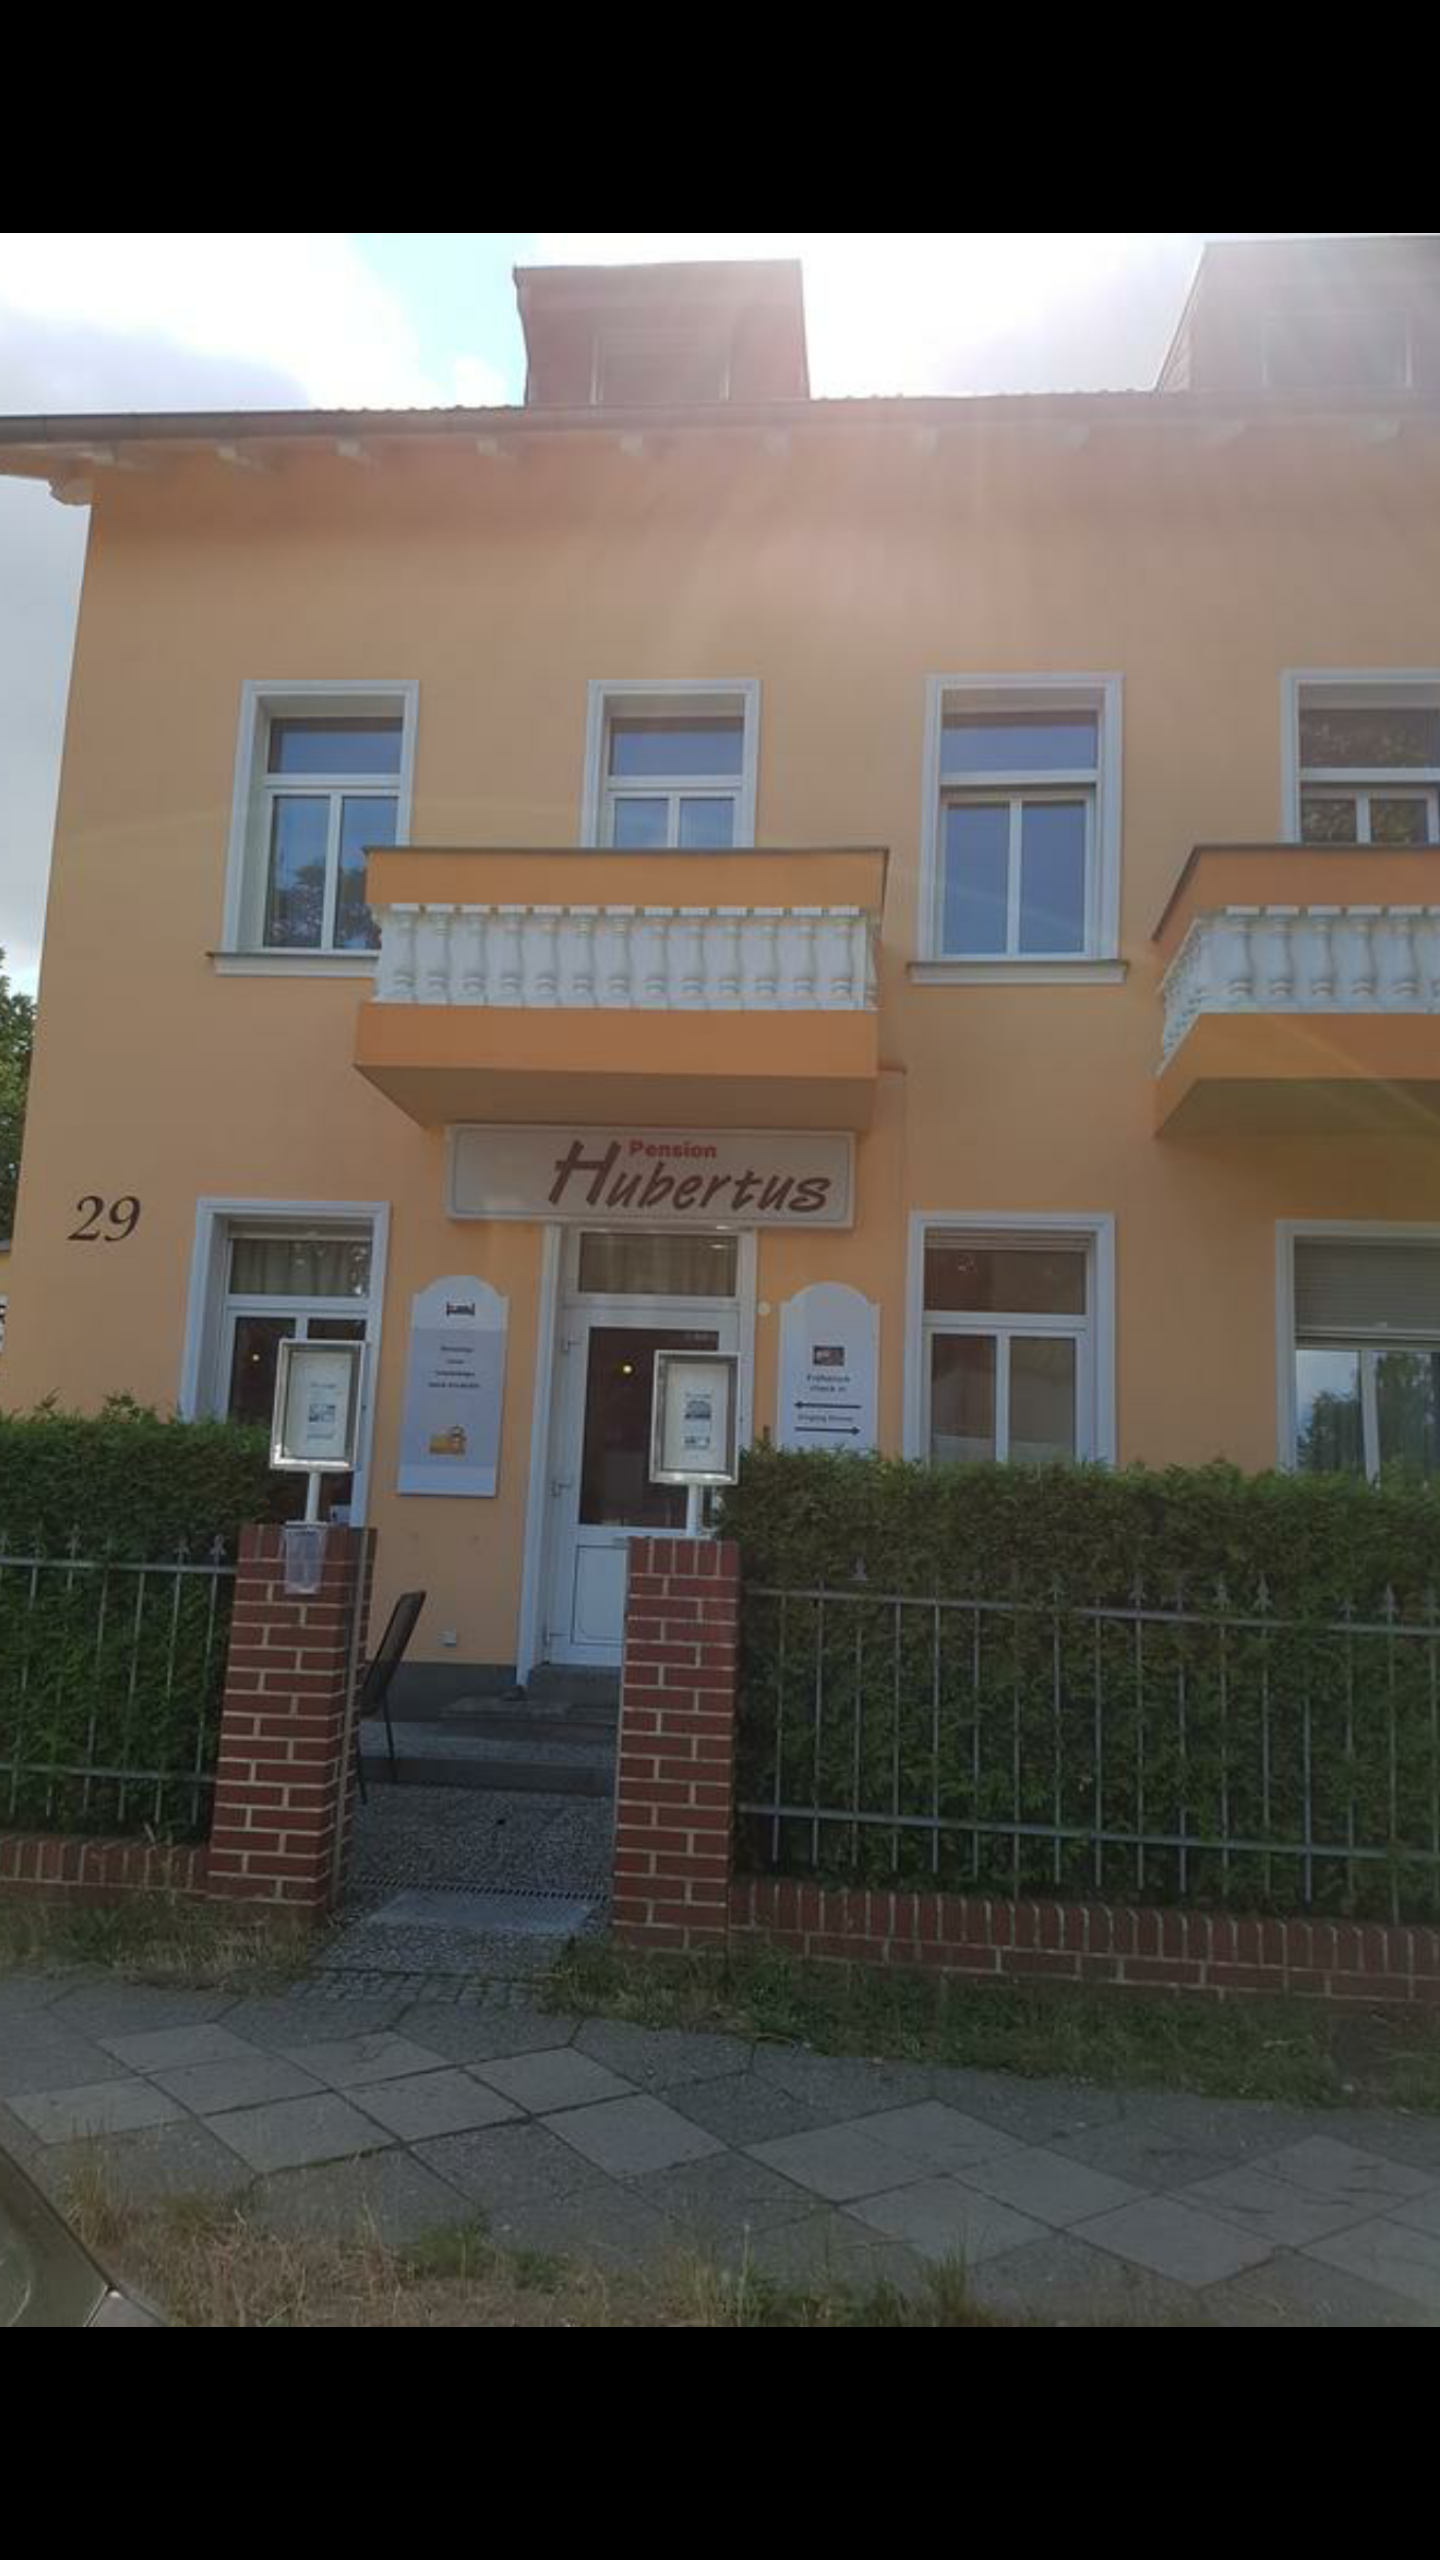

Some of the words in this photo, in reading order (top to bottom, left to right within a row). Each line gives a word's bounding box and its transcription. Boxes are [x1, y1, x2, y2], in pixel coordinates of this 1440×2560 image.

[628, 1139, 717, 1159] Pension
[548, 1140, 831, 1211] Hubertus
[68, 1195, 141, 1243] 29
